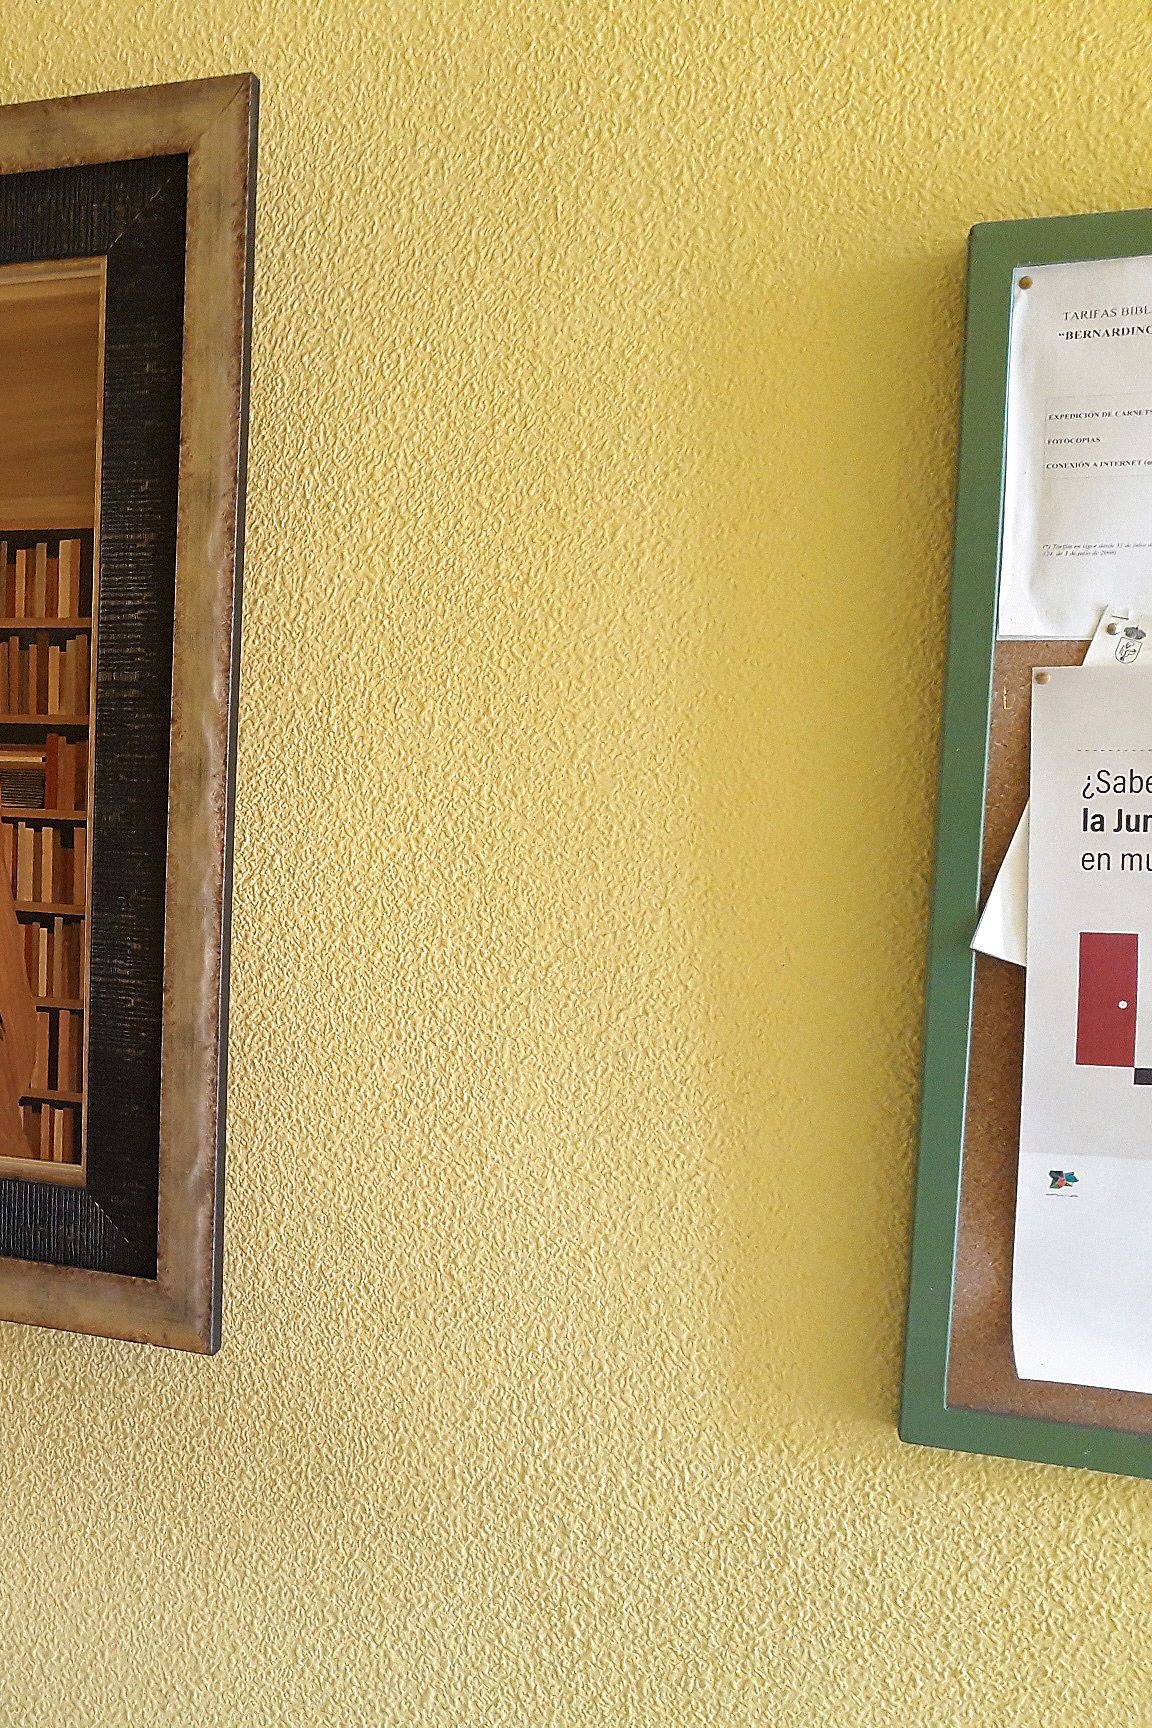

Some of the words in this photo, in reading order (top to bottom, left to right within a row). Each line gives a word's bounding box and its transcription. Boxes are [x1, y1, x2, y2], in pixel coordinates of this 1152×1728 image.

[1063, 308, 1117, 320] TARIFAS
[1047, 437, 1101, 445] FOTOCOPIAS
[1083, 807, 1105, 832] la
[1081, 852, 1111, 871] en
